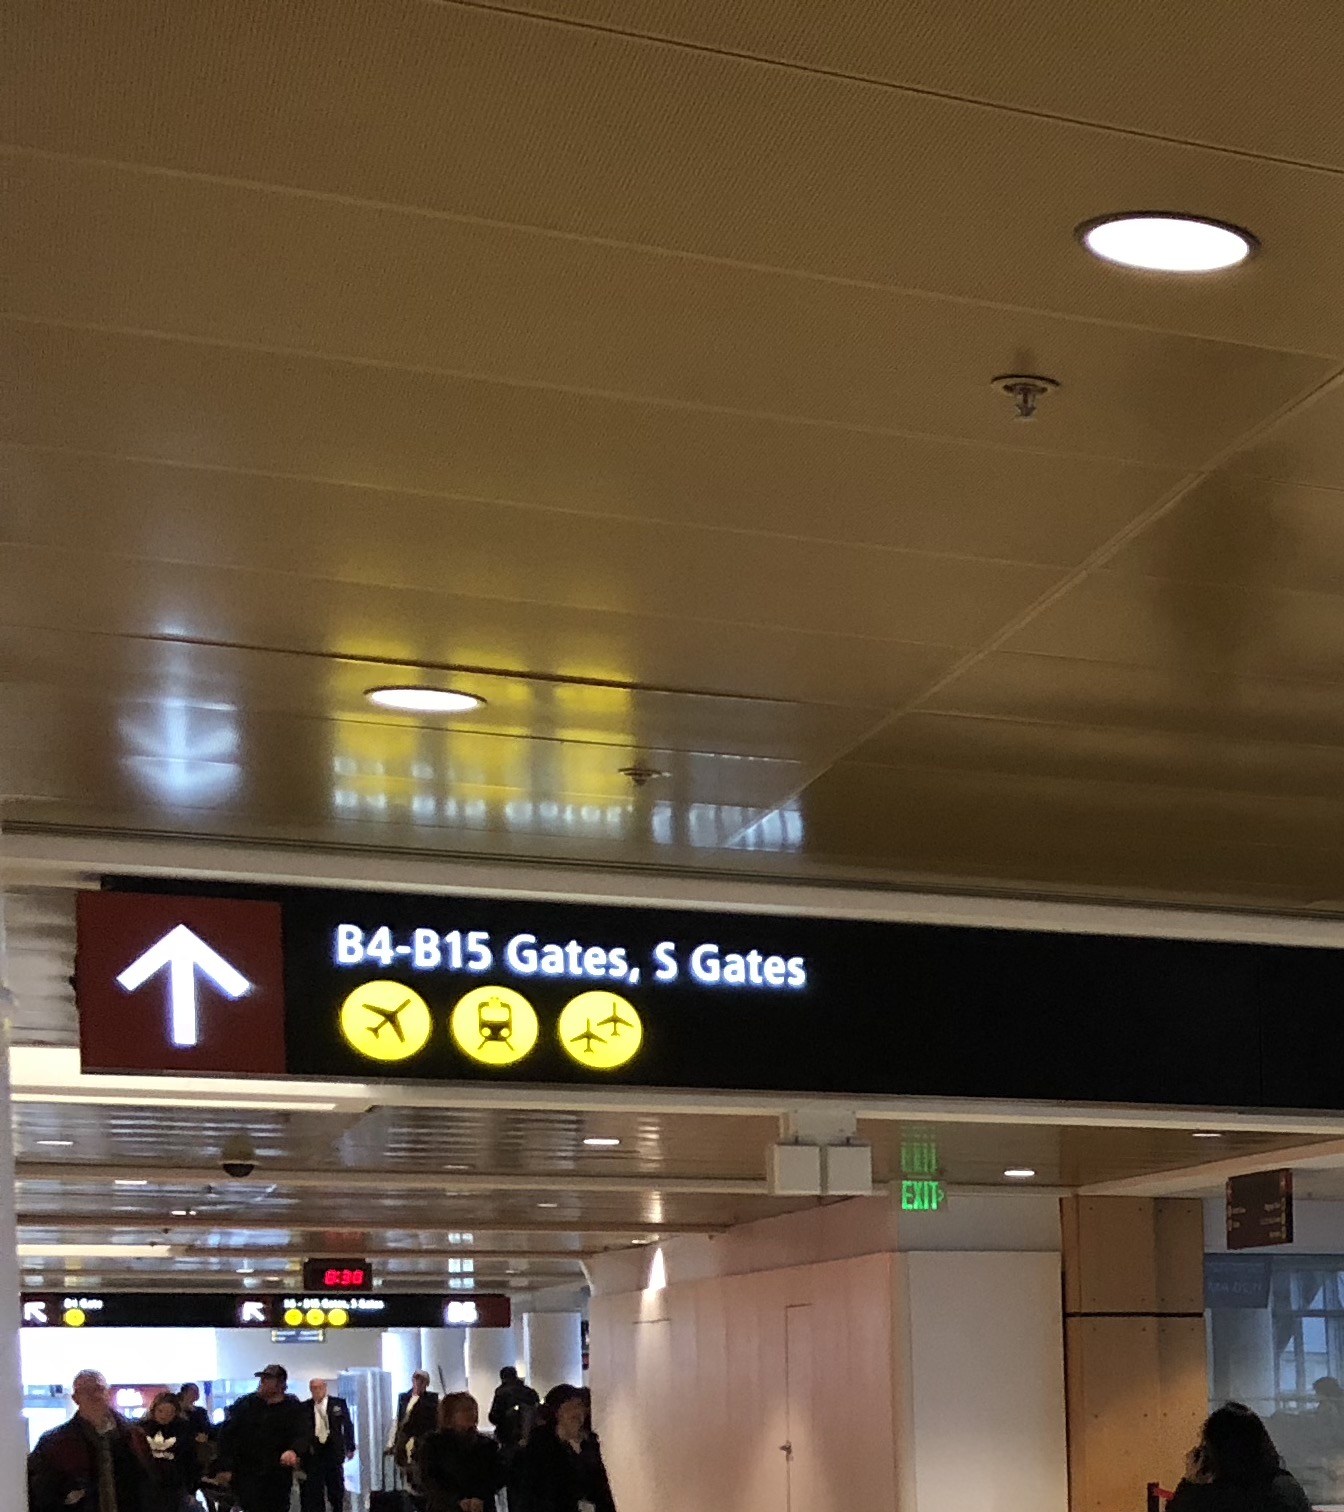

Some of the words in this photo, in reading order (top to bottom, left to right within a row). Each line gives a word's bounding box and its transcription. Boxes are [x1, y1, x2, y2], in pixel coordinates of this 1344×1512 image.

[336, 923, 493, 971] B4-B15
[506, 933, 641, 984] Gates,
[654, 941, 679, 980] S
[691, 943, 807, 987] Gates
[902, 1180, 938, 1209] EXIT
